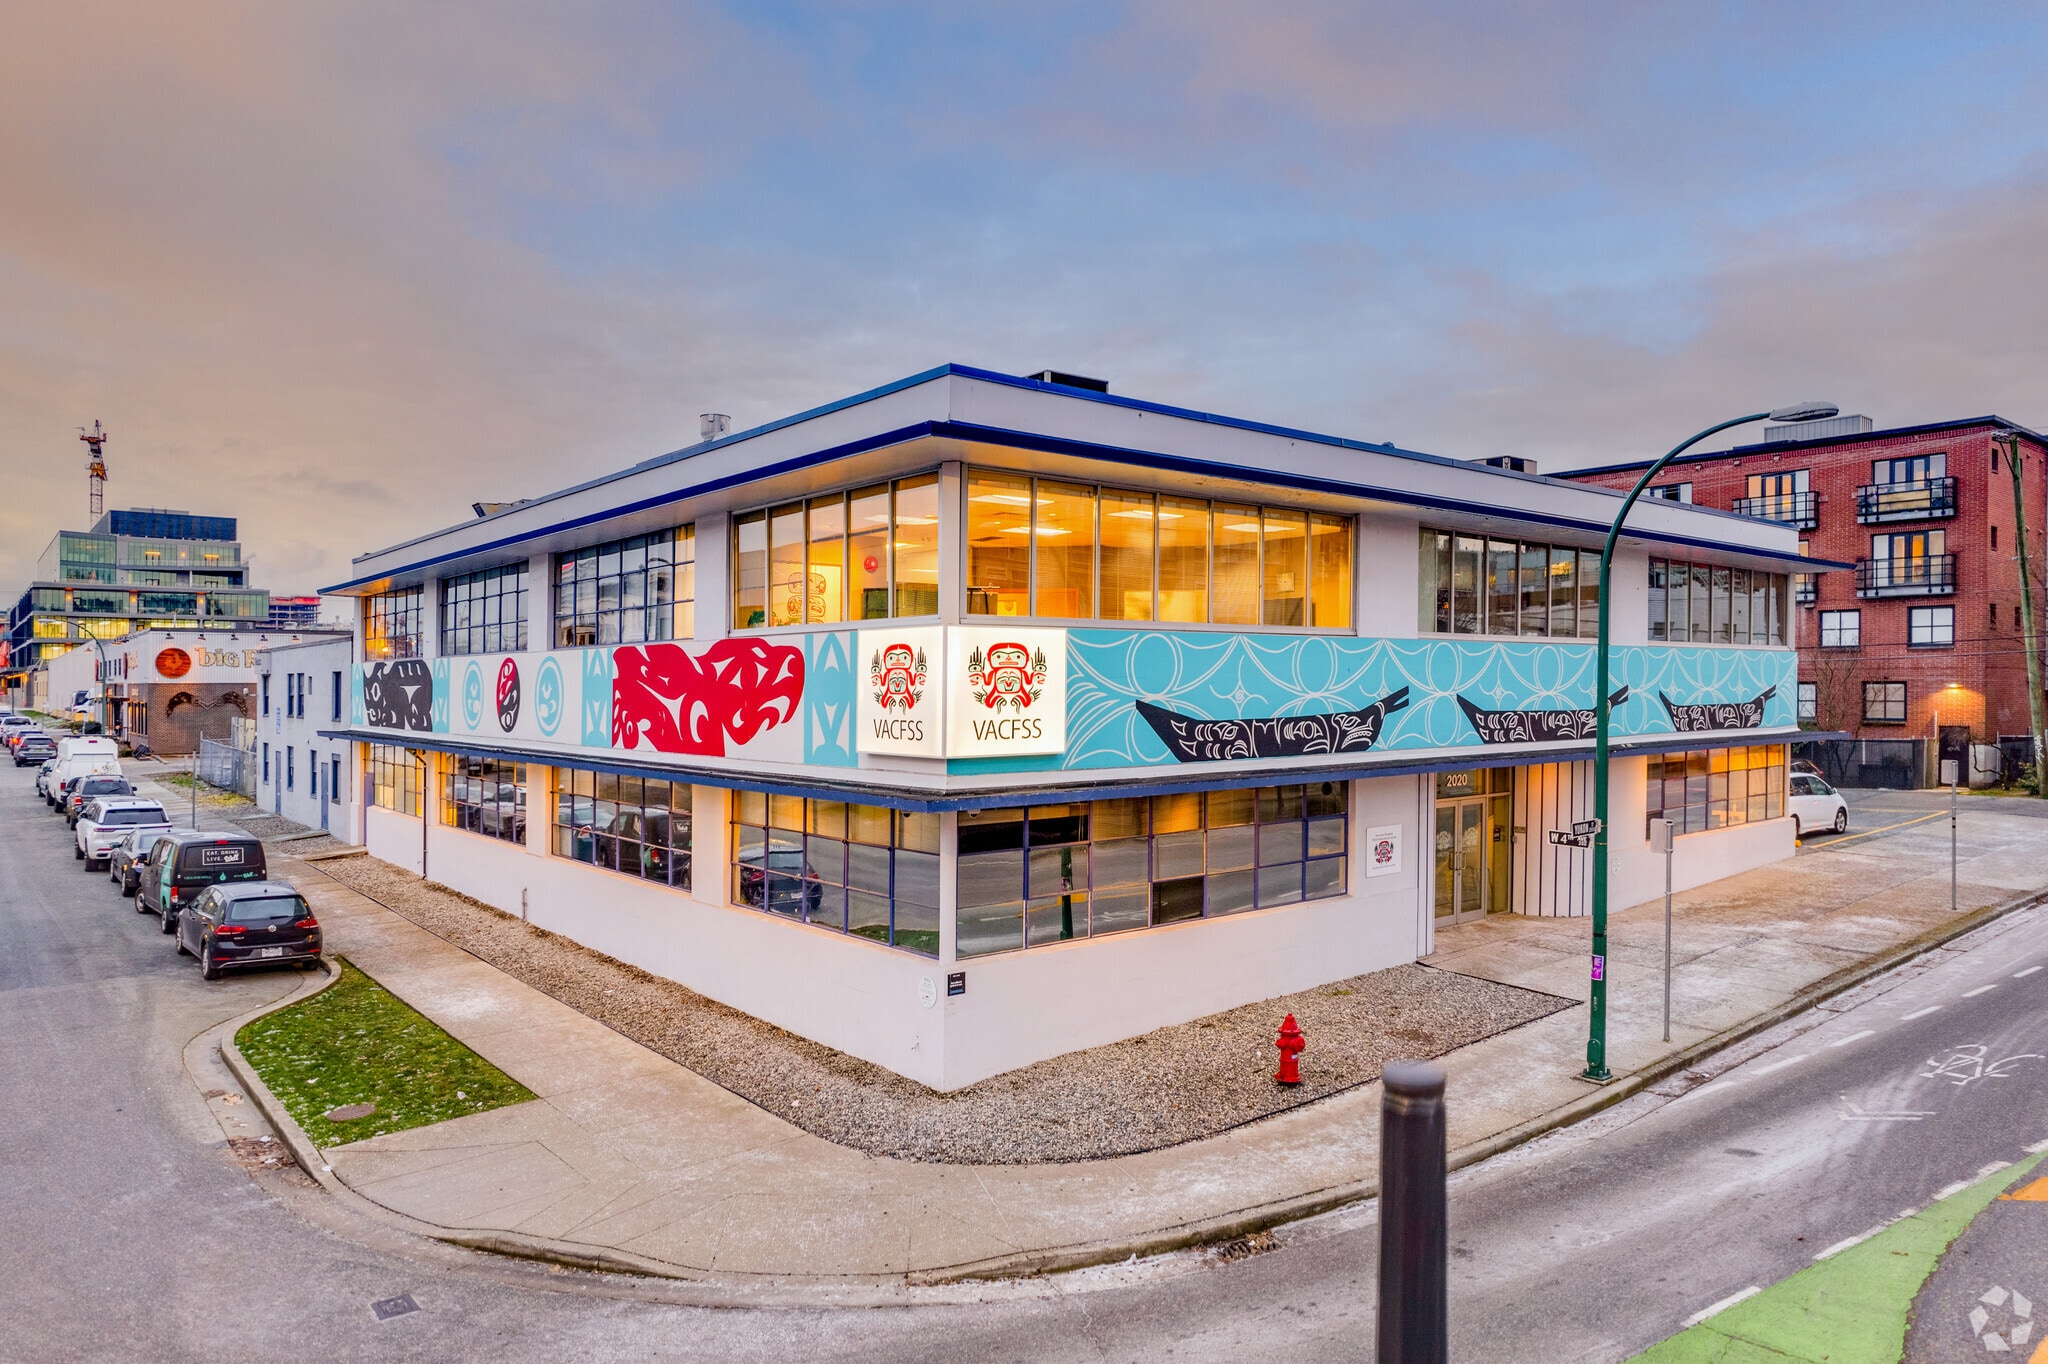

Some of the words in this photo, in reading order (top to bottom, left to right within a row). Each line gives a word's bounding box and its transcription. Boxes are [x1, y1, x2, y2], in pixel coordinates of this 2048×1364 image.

[873, 719, 924, 741] VACFSS
[972, 718, 1042, 741] VACFSS
[1446, 774, 1468, 787] 2020
[1551, 832, 1559, 843] W
